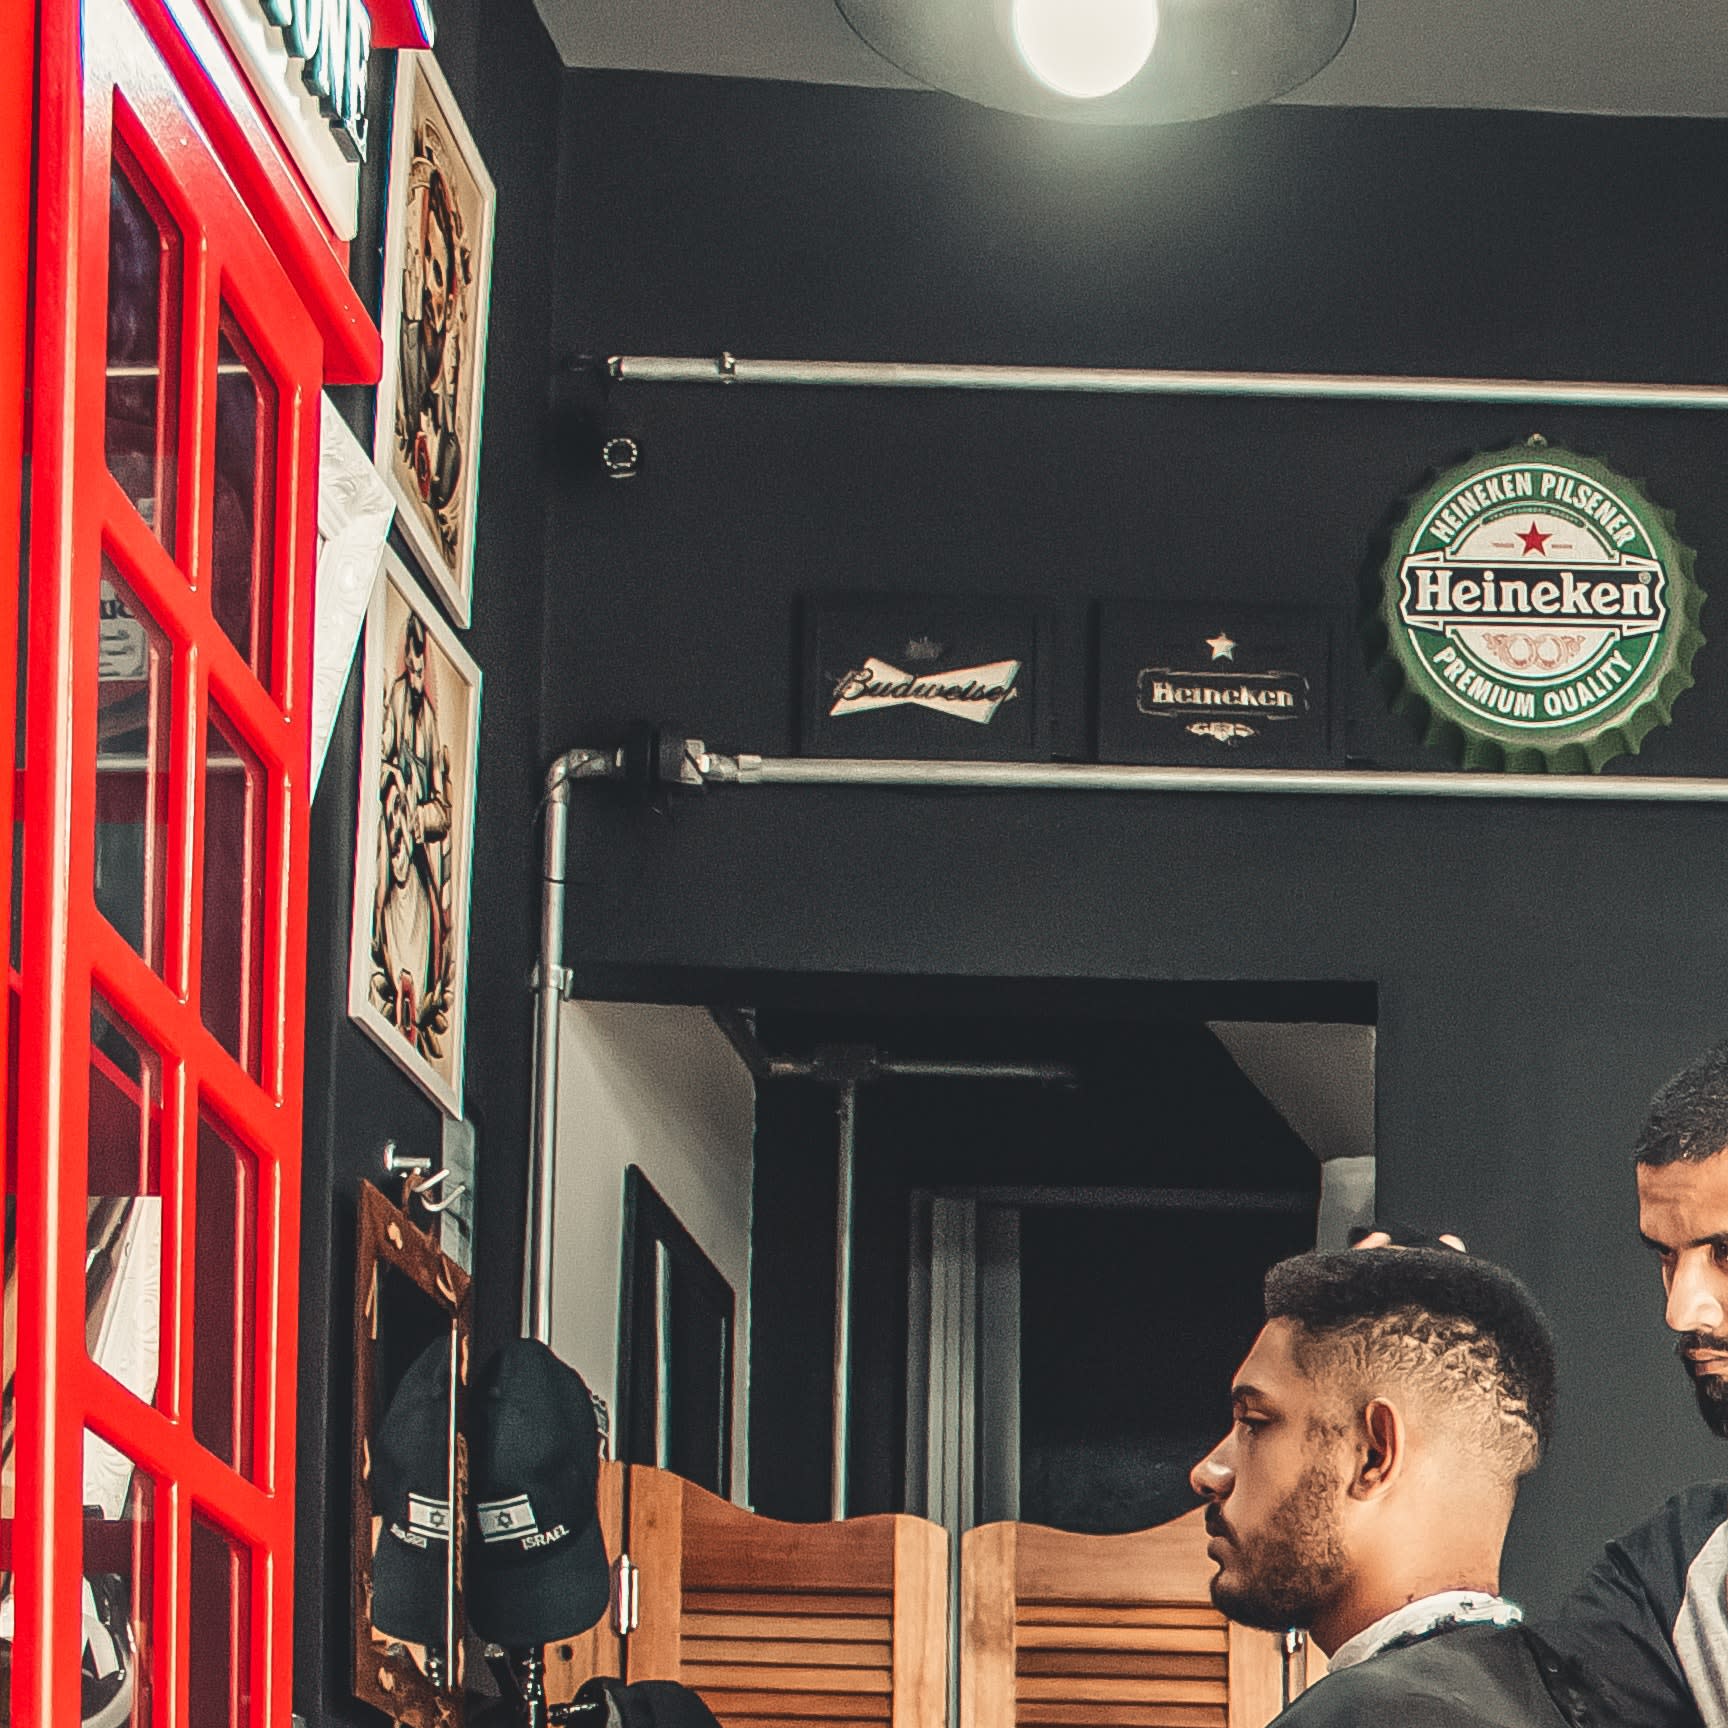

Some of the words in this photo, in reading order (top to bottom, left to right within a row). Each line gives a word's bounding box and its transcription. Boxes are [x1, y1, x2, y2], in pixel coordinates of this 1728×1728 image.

[1430, 471, 1533, 543] HEINEKEN
[1540, 472, 1636, 548] PILSENER
[1414, 568, 1653, 616] Heineken
[832, 667, 1018, 701] Budweiser
[1152, 681, 1294, 707] Heineken
[1433, 647, 1536, 719] PREMIUM
[1544, 650, 1632, 717] QUALITY
[521, 1524, 570, 1550] ISRAEL
